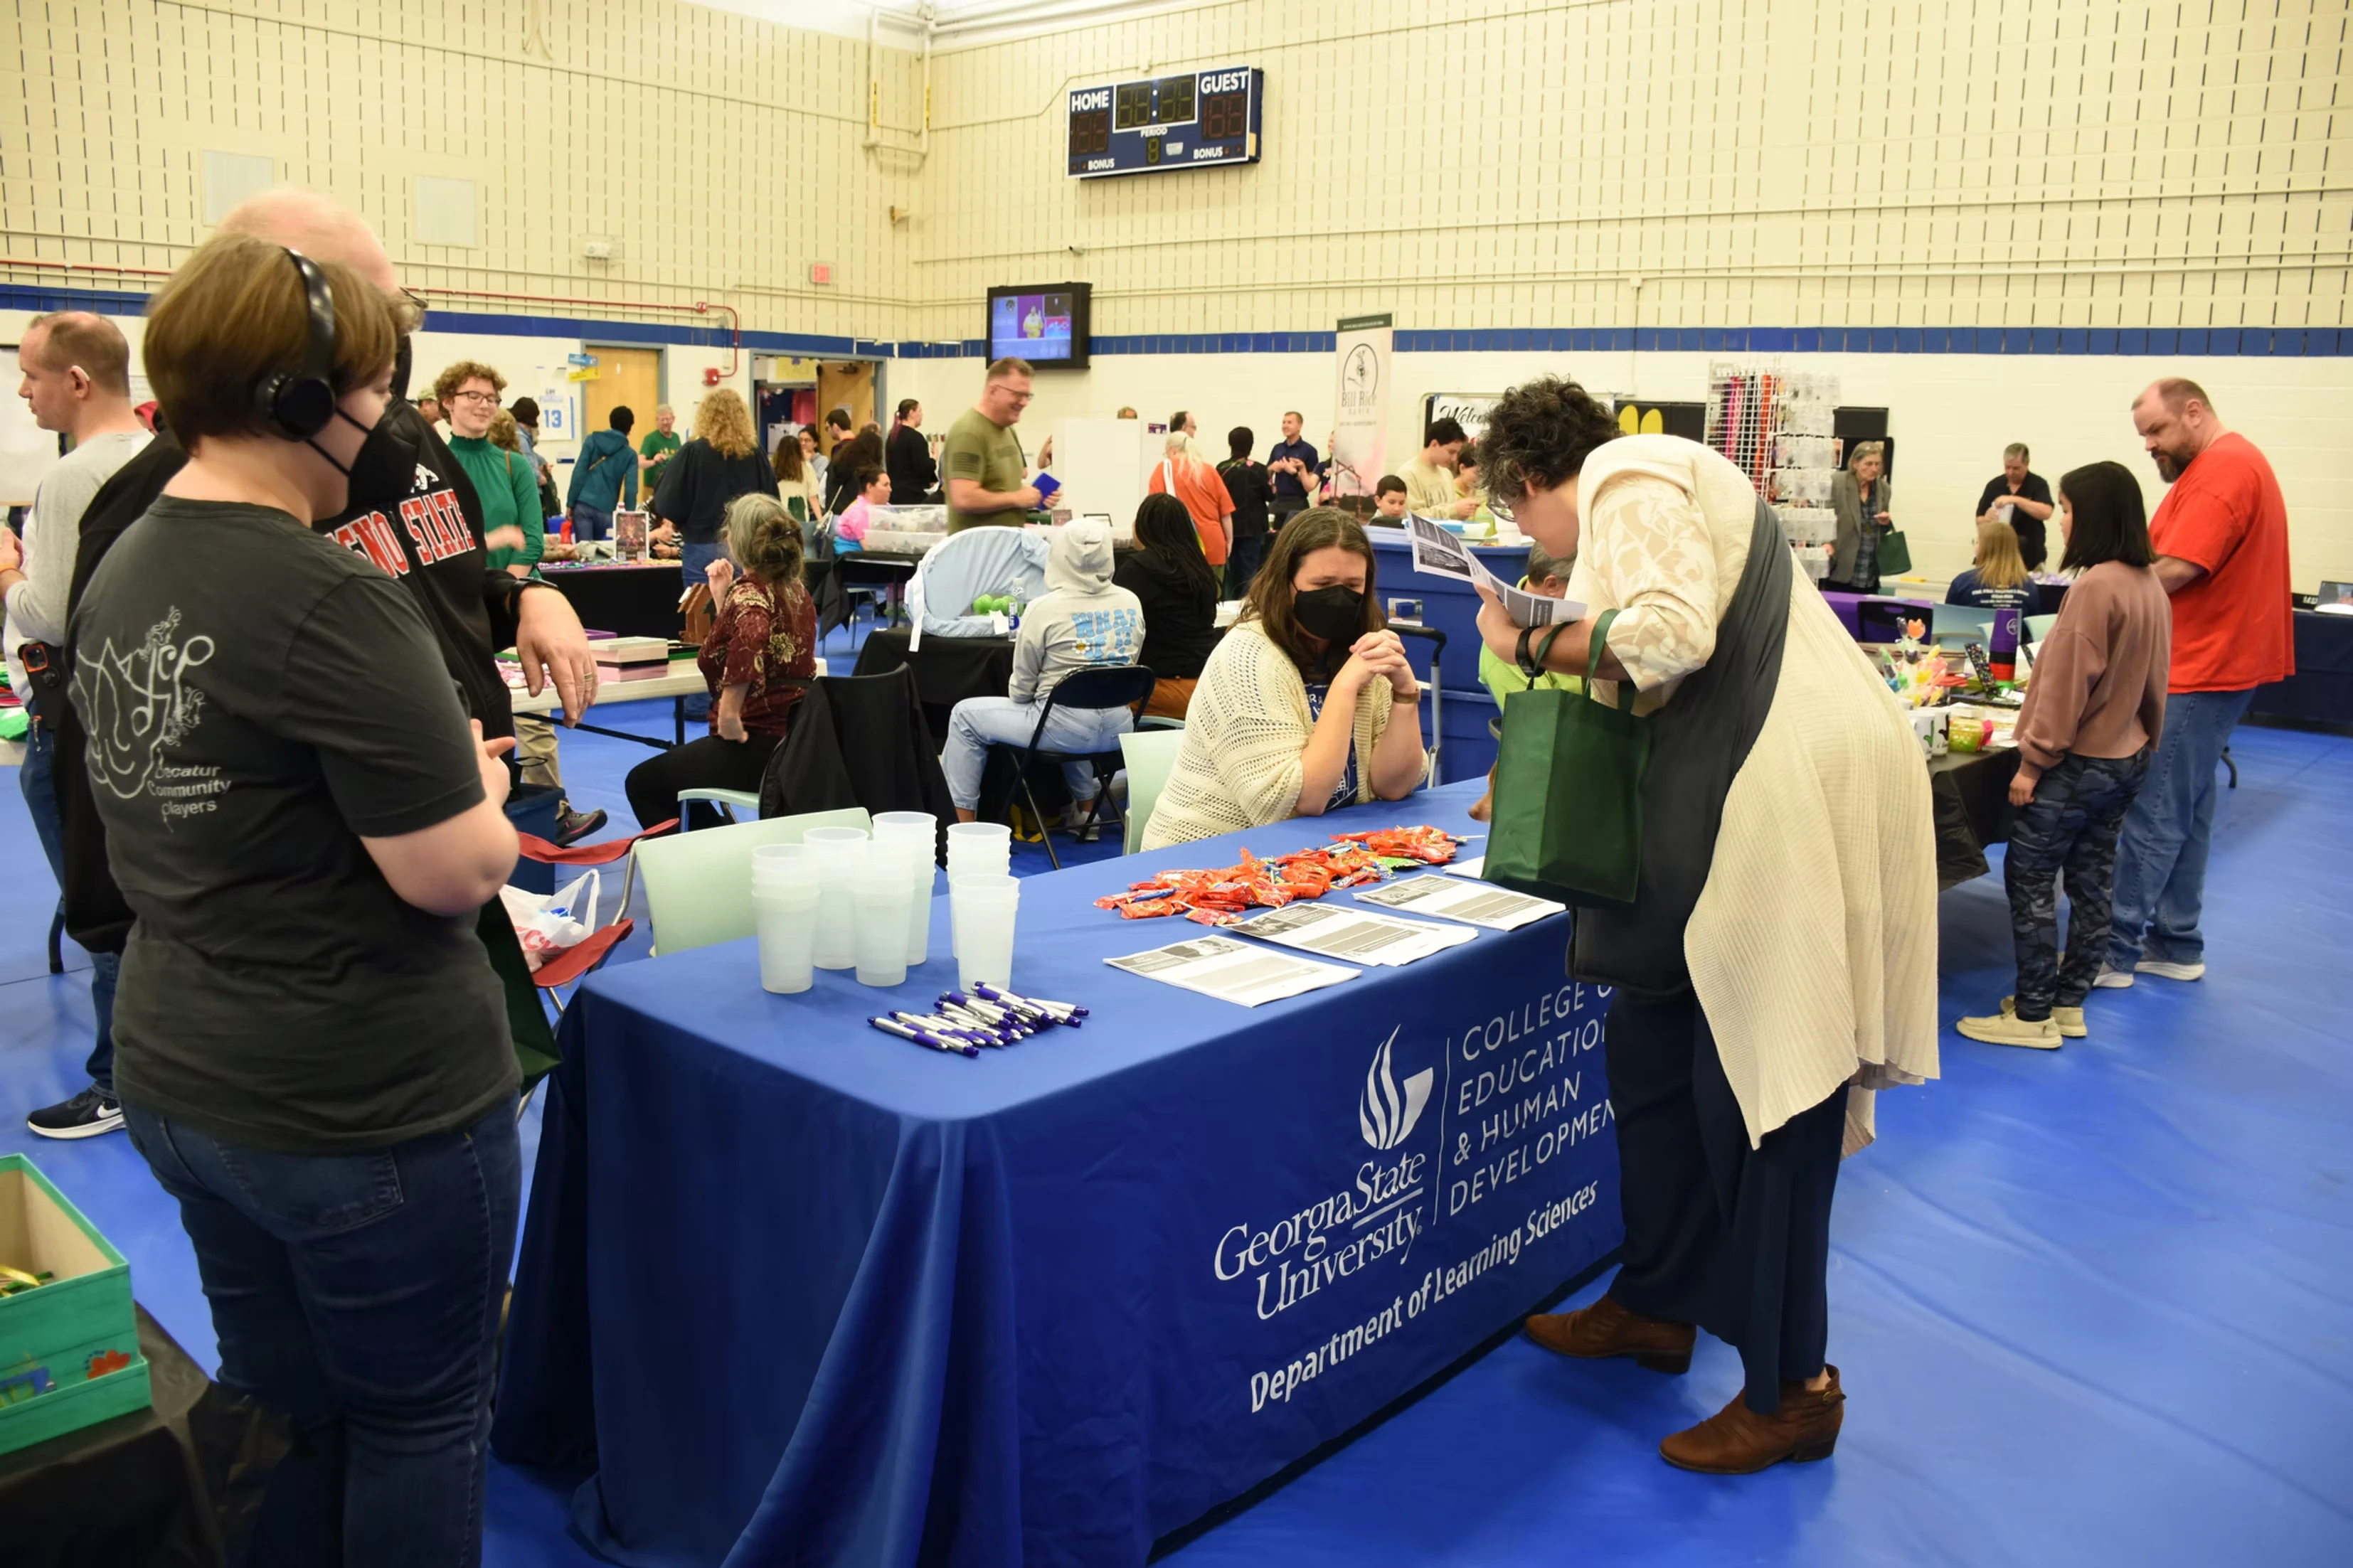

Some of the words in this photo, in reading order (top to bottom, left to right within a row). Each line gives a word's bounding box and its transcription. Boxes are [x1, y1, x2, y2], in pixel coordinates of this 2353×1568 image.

[1201, 71, 1248, 94] GUEST
[1071, 91, 1110, 112] HOME
[1140, 127, 1168, 137] PERIOD
[1088, 159, 1115, 170] BONUS
[1194, 146, 1223, 159] BONUS
[543, 409, 563, 429] 13
[1073, 608, 1137, 639] WHAT
[1462, 982, 1585, 1061] COLLEGE
[1452, 1132, 1472, 1166] &
[1480, 1071, 1581, 1153] HUMAN
[1450, 1099, 1615, 1217] DEVELOPMEN
[1256, 1205, 1423, 1321] University
[1251, 1296, 1403, 1414] Department
[1408, 1272, 1433, 1320] of
[1434, 1225, 1521, 1303] Learning
[1525, 1180, 1599, 1246] Sciences
